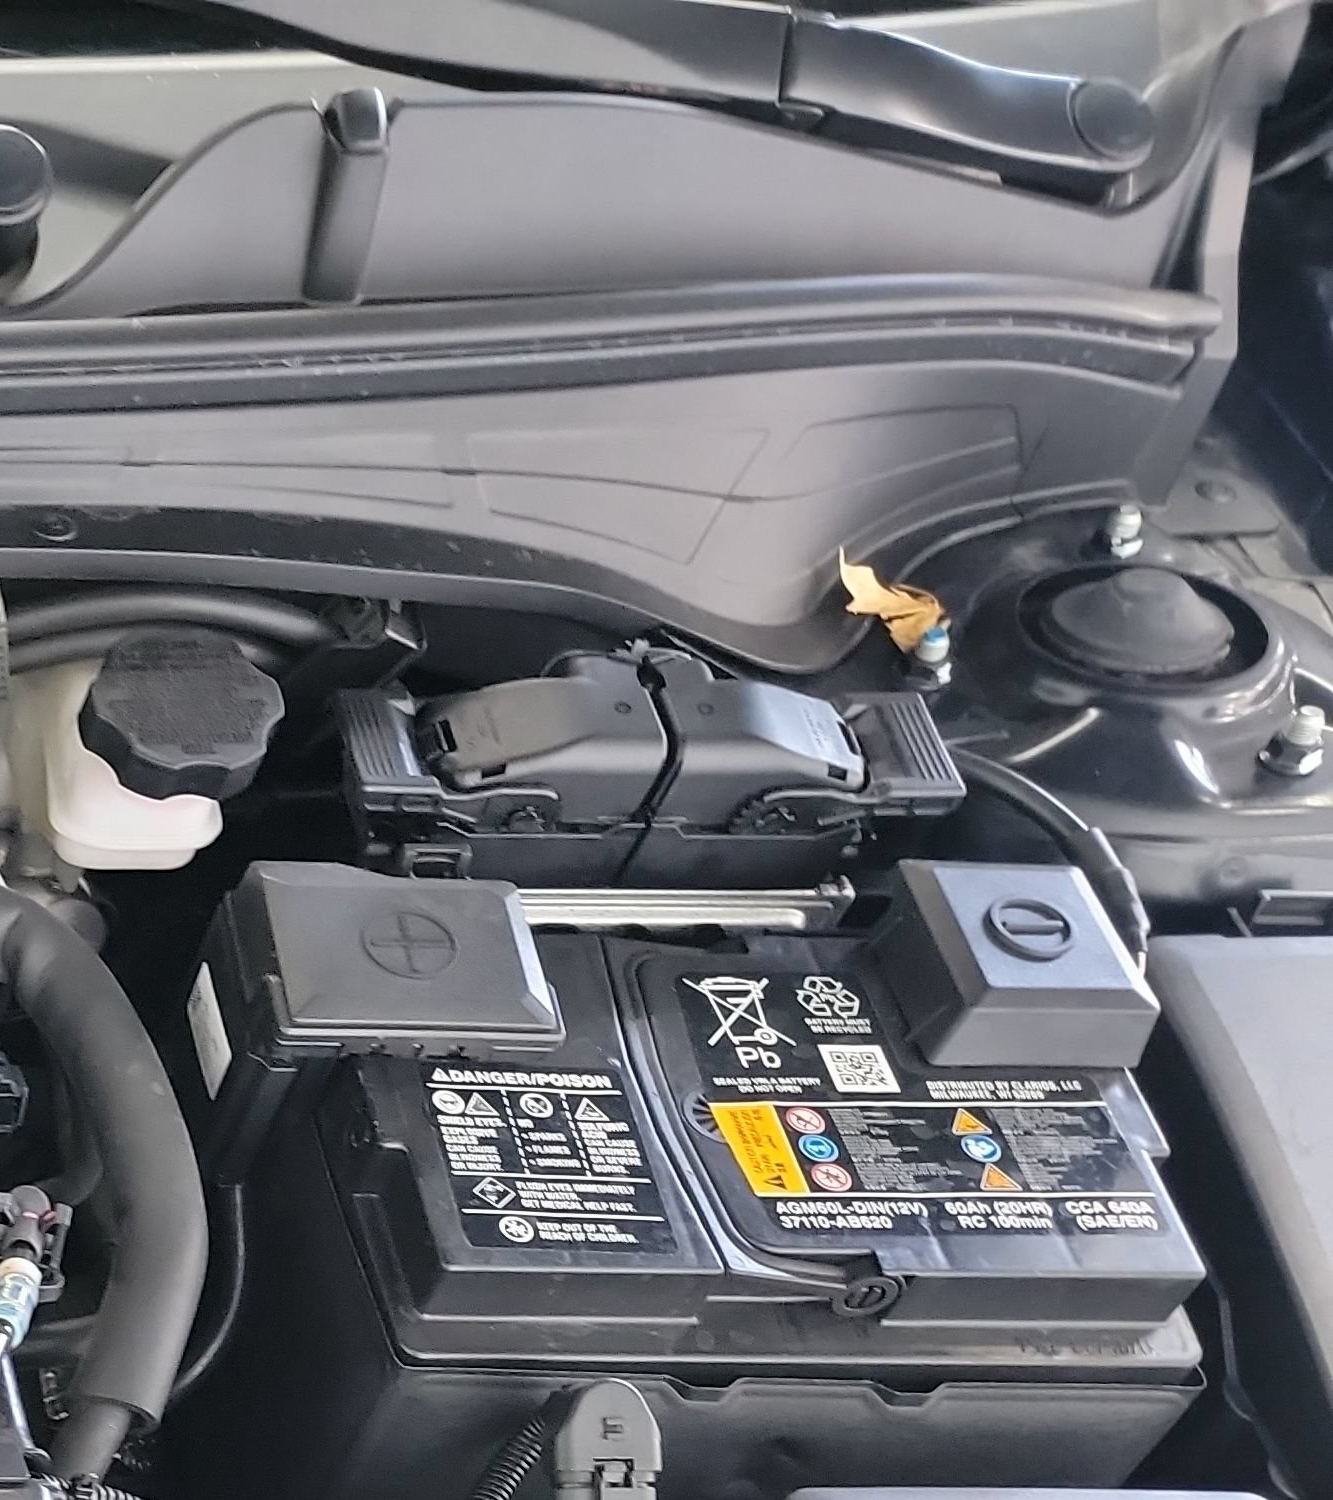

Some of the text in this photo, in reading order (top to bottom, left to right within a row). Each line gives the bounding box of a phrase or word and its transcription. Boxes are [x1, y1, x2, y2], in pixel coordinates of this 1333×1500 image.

[735, 1047, 782, 1069] Pb
[448, 1069, 613, 1089] DANGER/POISON
[713, 1077, 753, 1087] SEALED
[778, 1077, 821, 1087] BATTERY
[925, 1080, 995, 1092] DISTRIBUTED
[994, 1080, 1010, 1091] BY
[737, 1084, 803, 1094] DO NOT OPEN
[944, 1201, 1053, 1217] 60Ah (20HR)
[1064, 1201, 1106, 1215] CCA
[957, 1215, 1053, 1230] RC 100min
[1075, 1215, 1159, 1231] (SAE/EN)
